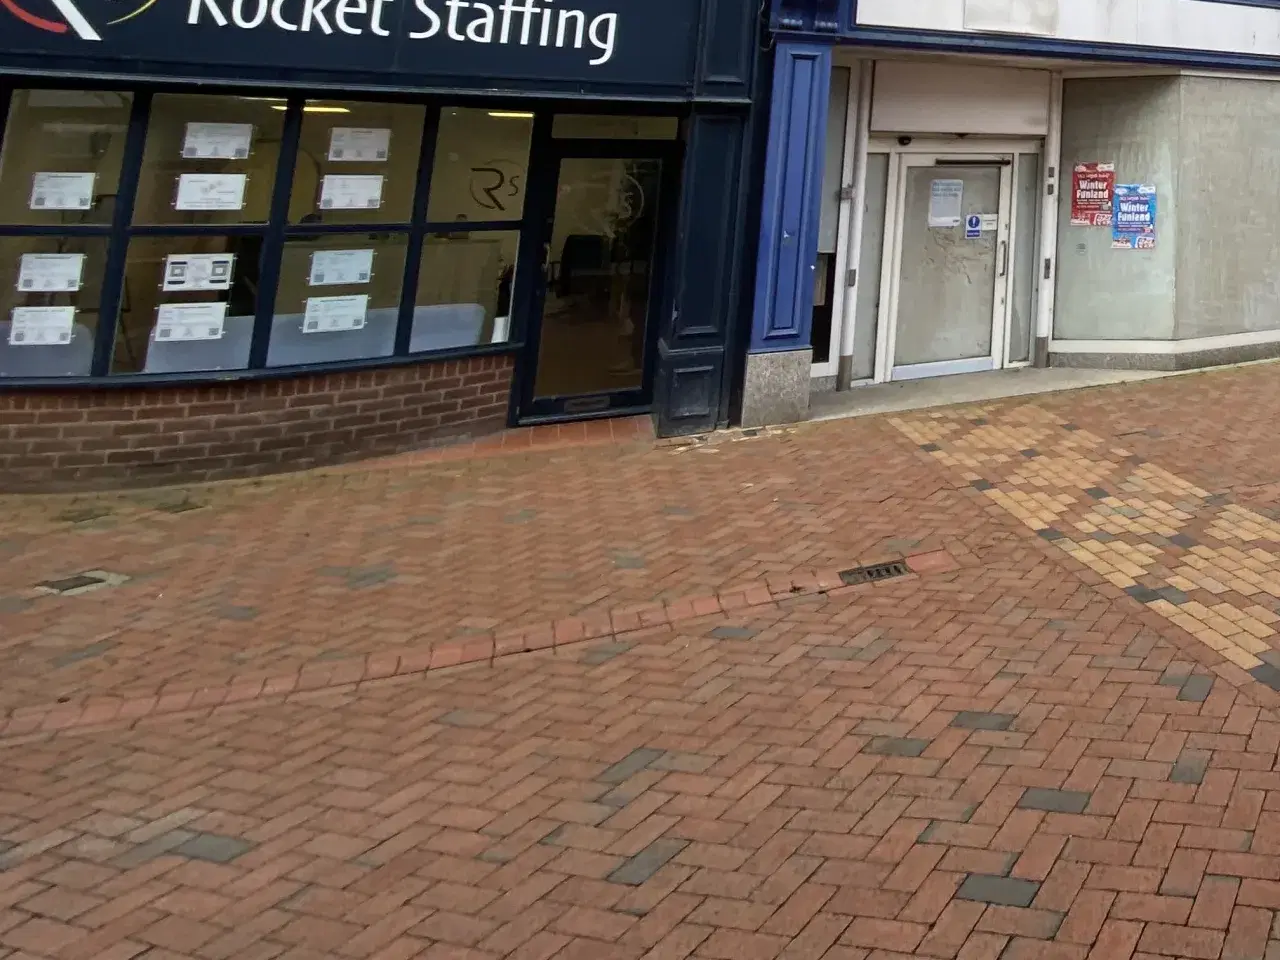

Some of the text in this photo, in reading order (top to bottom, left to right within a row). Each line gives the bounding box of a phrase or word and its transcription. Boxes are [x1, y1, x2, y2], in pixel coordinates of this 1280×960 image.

[1079, 179, 1108, 190] Winter
[1076, 189, 1109, 199] Funland
[1120, 201, 1149, 212] Winter
[1117, 211, 1151, 222] Funland
